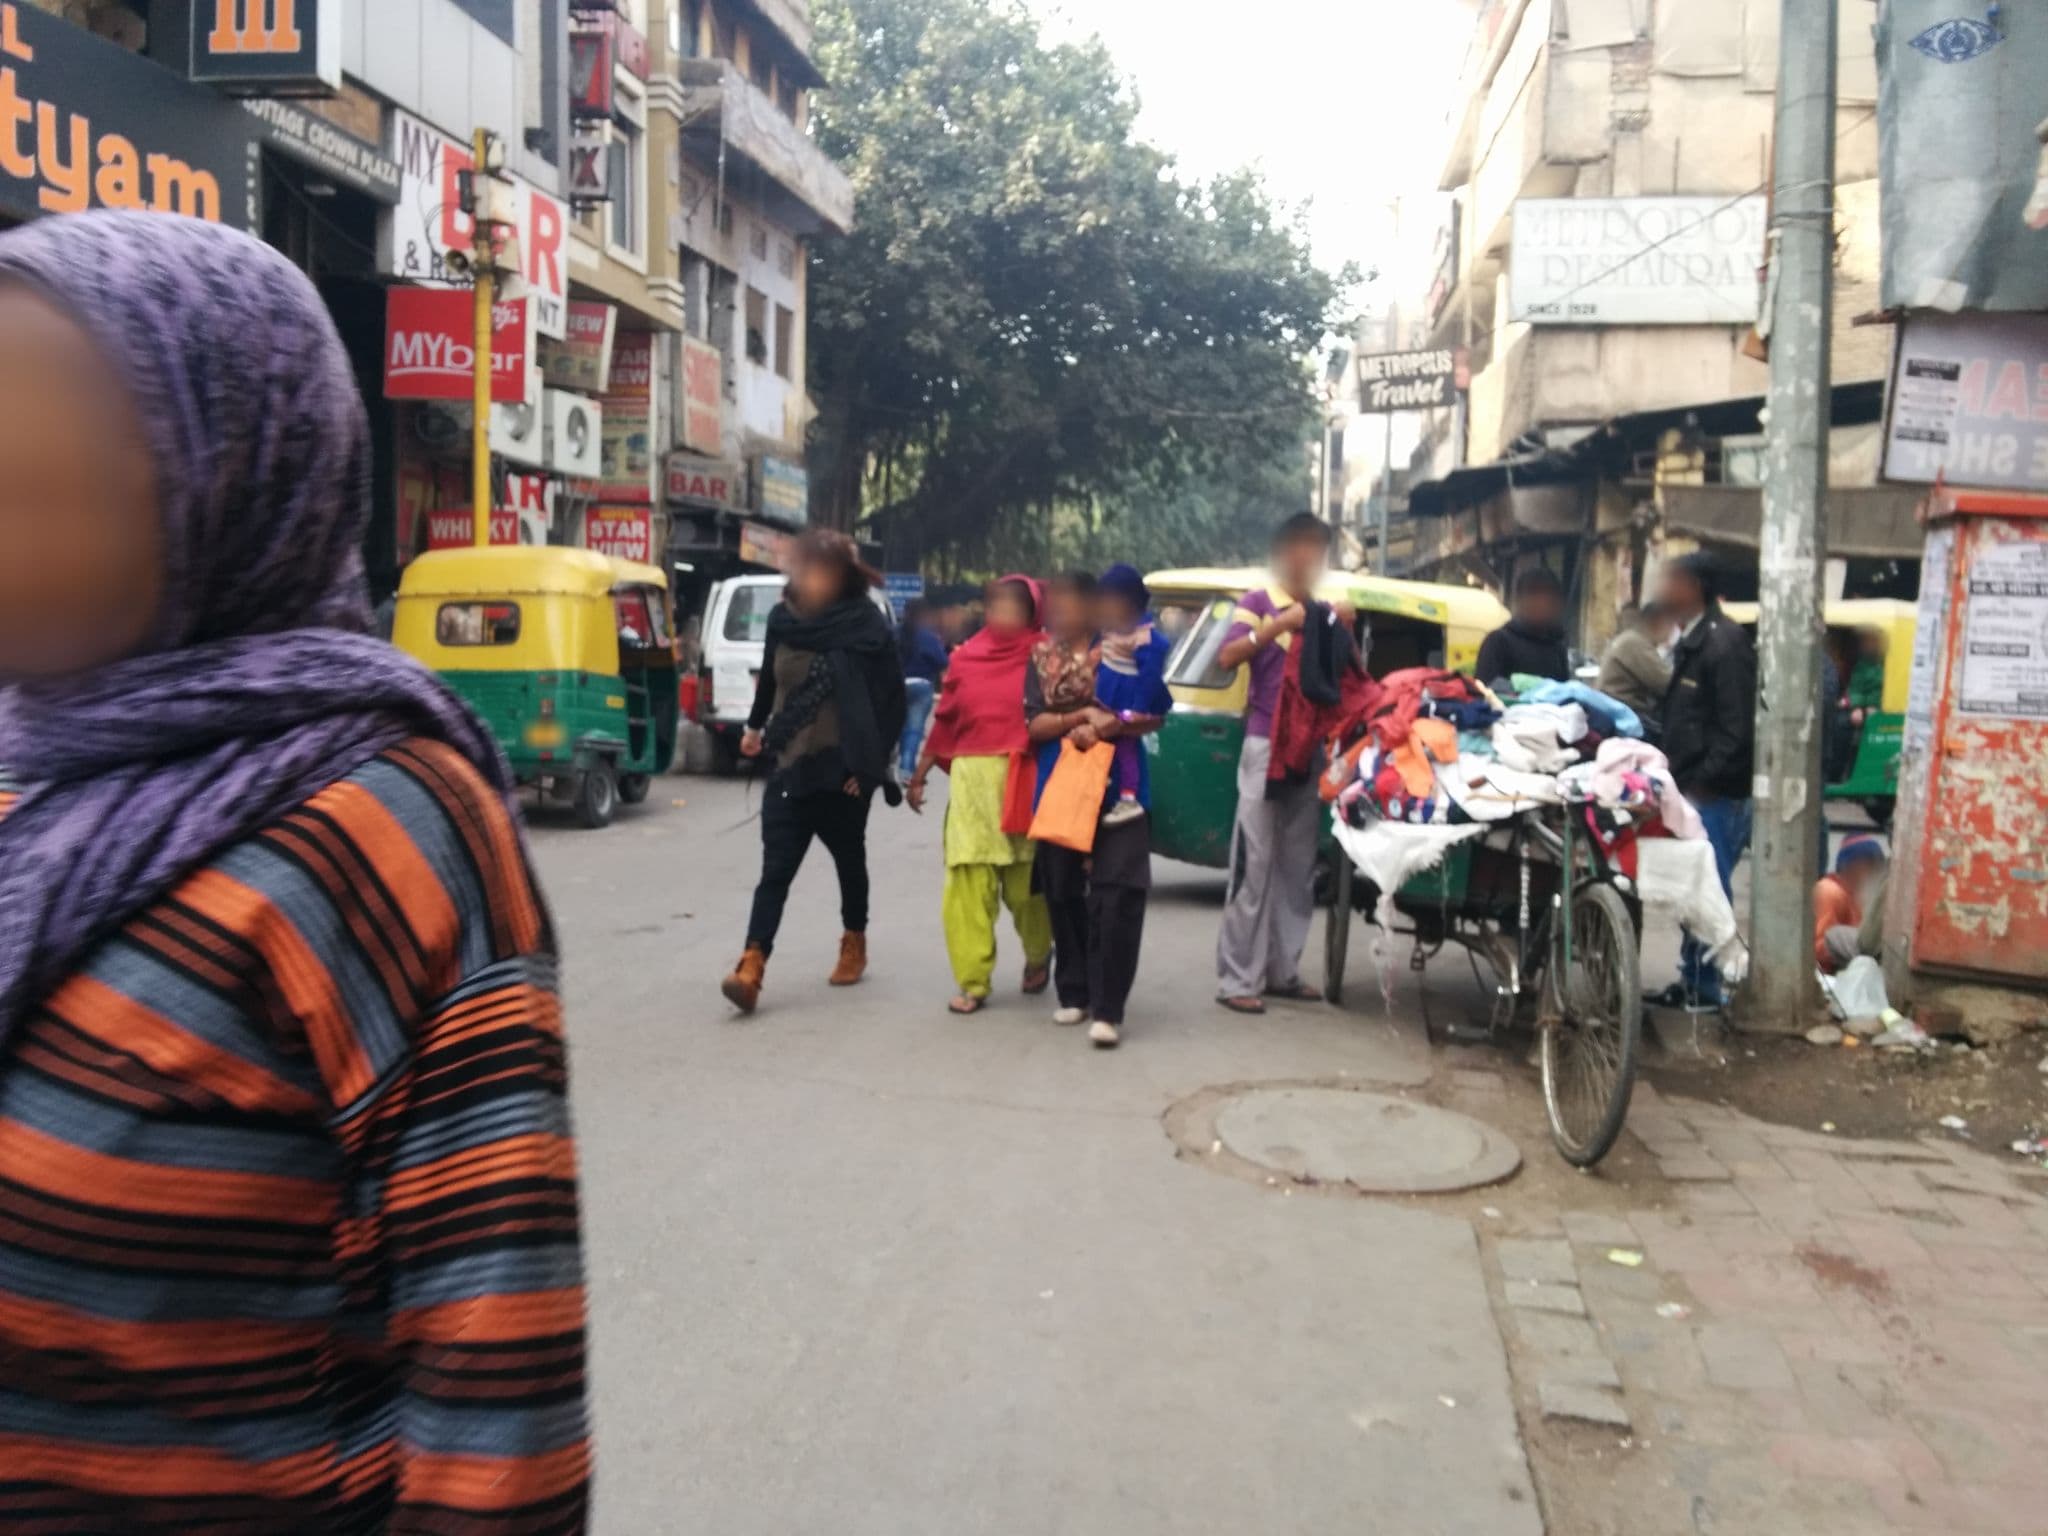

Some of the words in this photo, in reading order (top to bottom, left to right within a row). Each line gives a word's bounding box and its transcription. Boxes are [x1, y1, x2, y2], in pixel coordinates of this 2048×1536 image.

[309, 122, 358, 165] CROWN
[361, 149, 400, 188] PLAZA
[402, 120, 440, 185] MY
[1359, 349, 1453, 381] METROPOLIS
[1370, 377, 1444, 408] Travel
[671, 470, 728, 500] BAR
[430, 517, 516, 541] WHIKY
[591, 520, 646, 539] STAR
